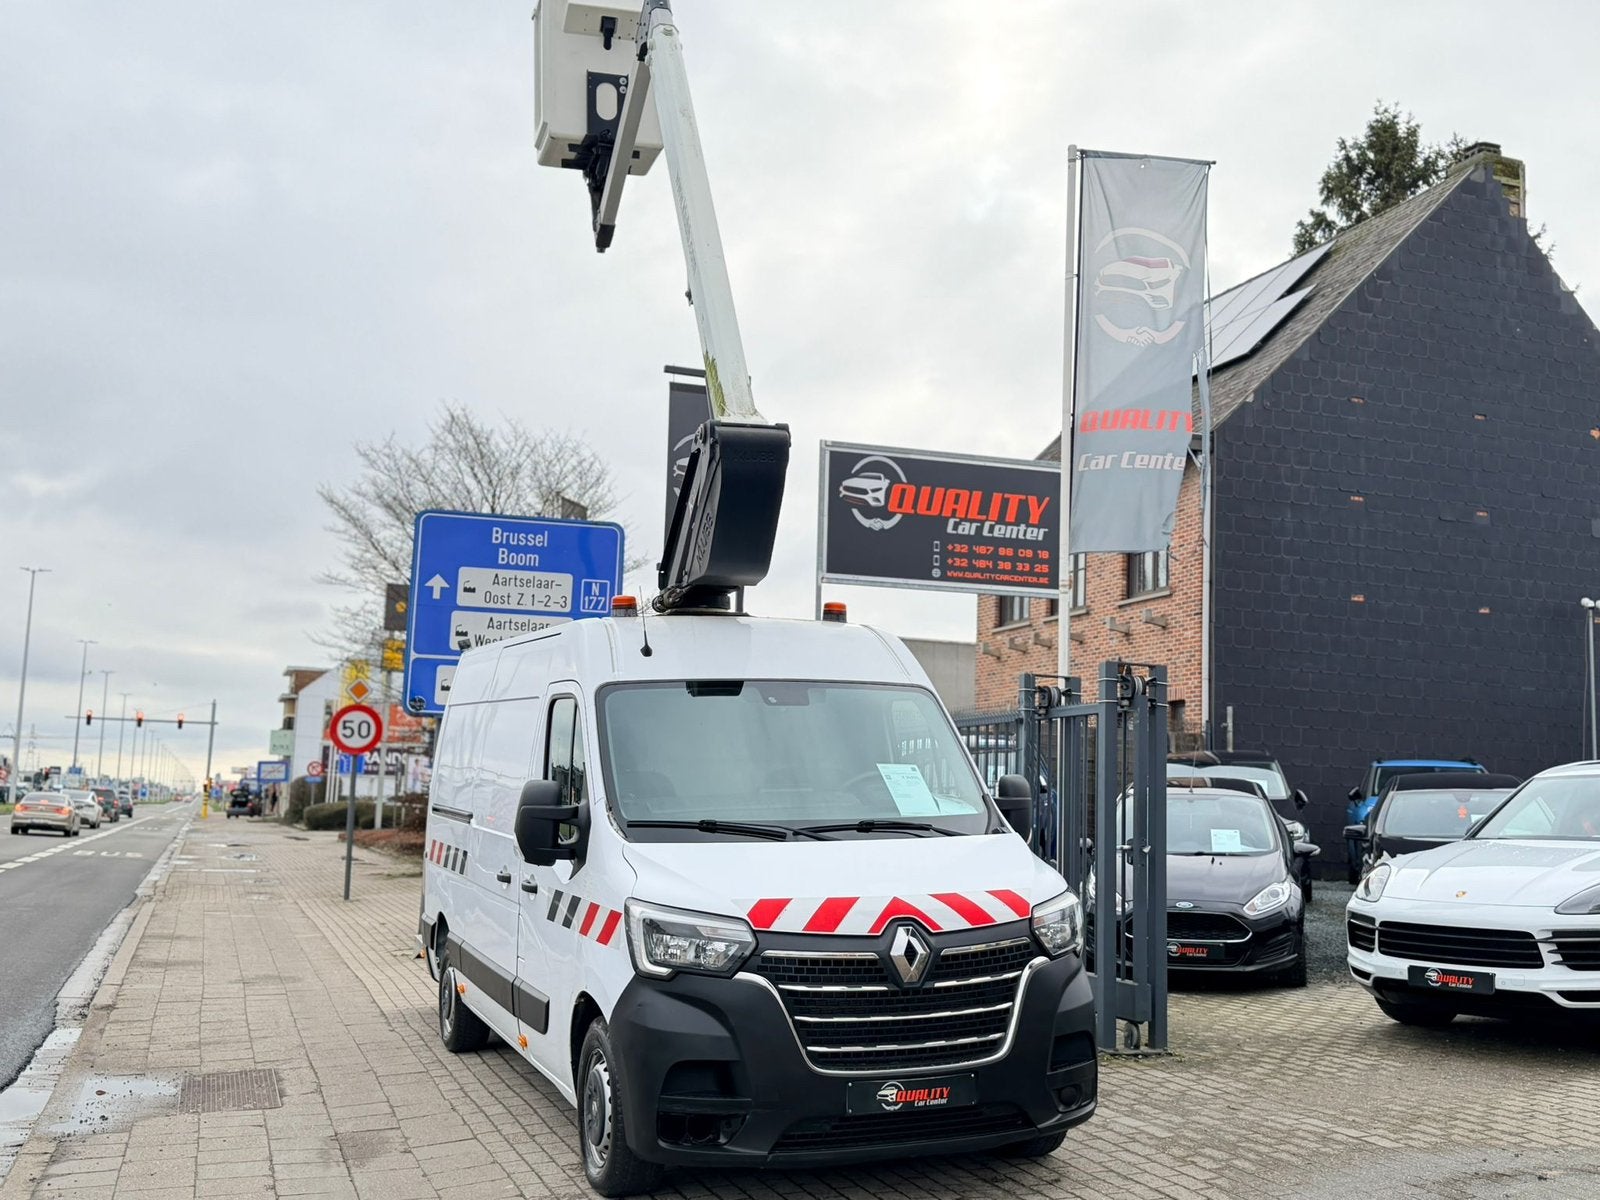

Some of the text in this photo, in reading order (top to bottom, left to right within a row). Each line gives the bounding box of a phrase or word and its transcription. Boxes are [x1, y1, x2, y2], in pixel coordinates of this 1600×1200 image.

[1078, 451, 1187, 472] Car Cente
[887, 483, 1050, 524] QUALITY
[492, 527, 548, 547] Brussel
[946, 518, 1049, 541] Car Center
[498, 548, 539, 567] Boom
[484, 591, 511, 605] Oost
[591, 583, 600, 595] N
[584, 597, 605, 610] 177
[341, 720, 371, 739] 50
[1437, 974, 1474, 985] QUALITY
[896, 1087, 950, 1102] QUALITY
